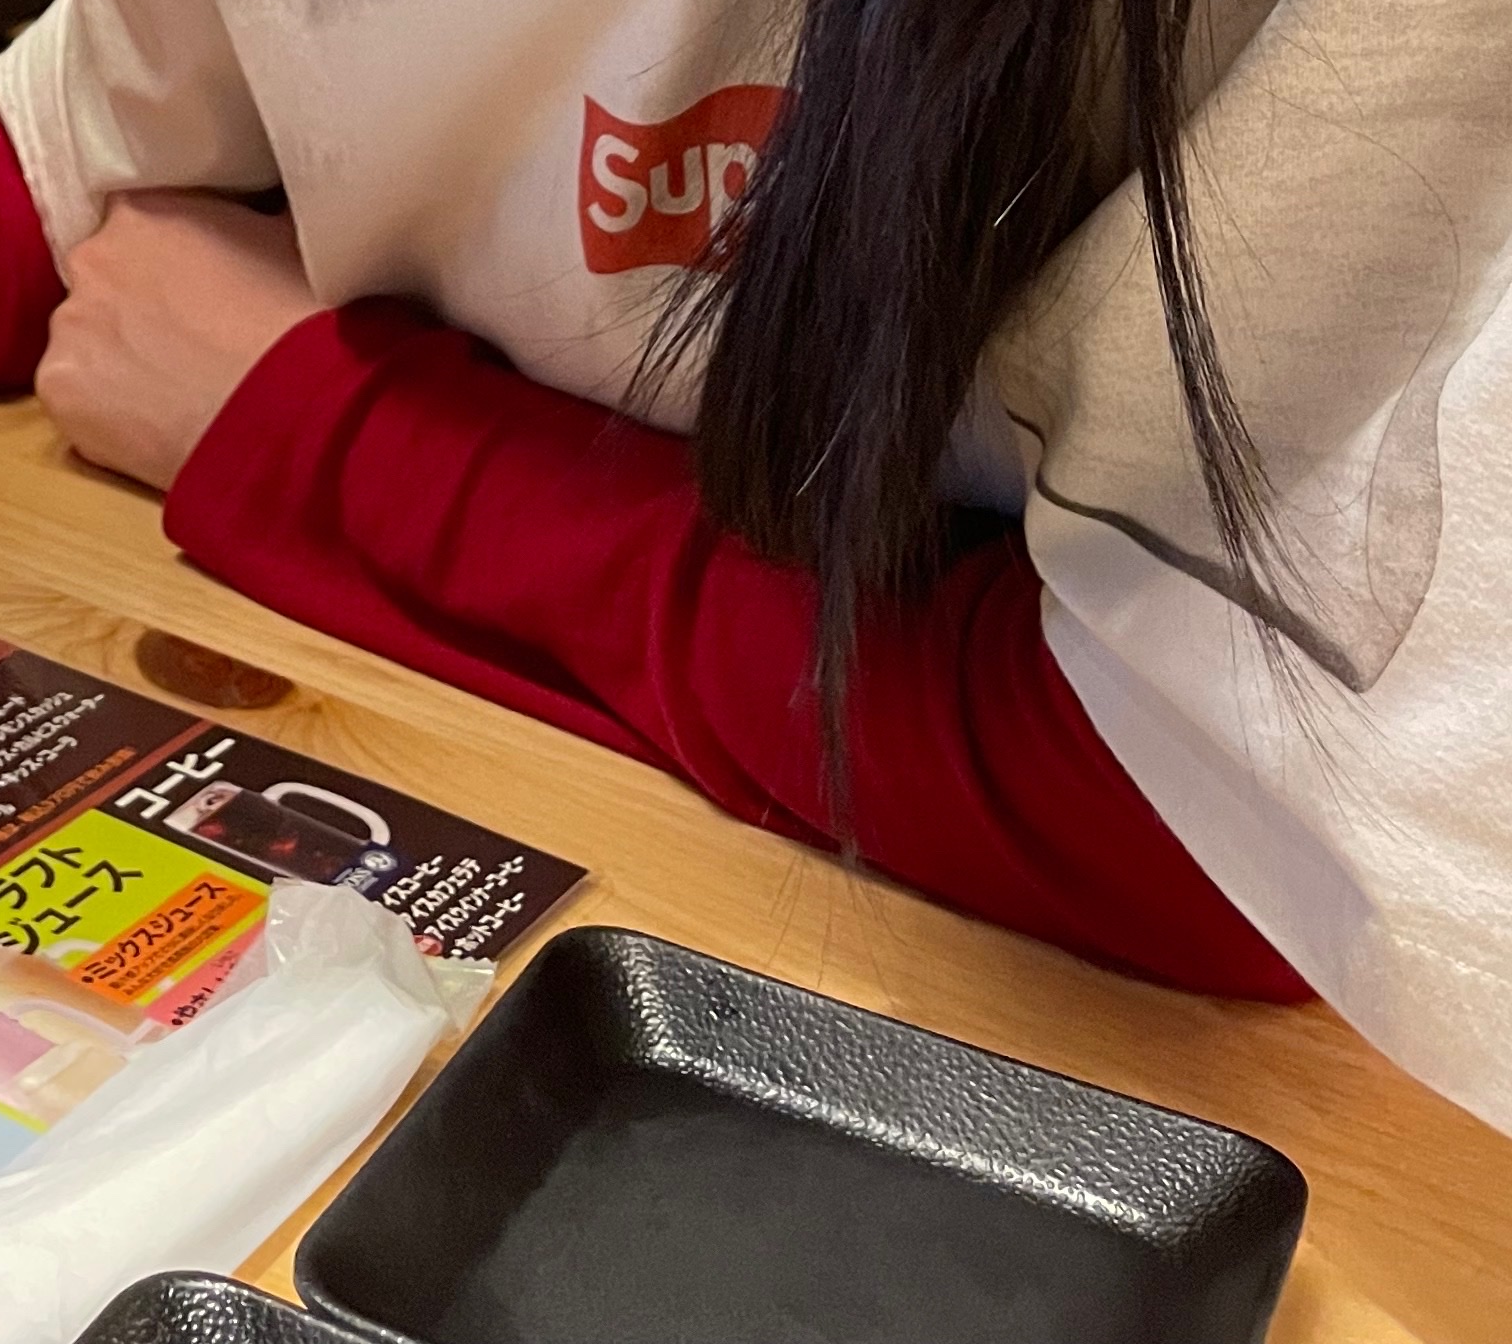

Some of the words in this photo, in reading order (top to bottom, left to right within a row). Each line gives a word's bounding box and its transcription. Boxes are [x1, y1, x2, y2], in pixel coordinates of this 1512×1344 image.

[0, 735, 78, 784] キッズ・コーラ
[114, 737, 235, 819] コーヒー
[84, 881, 227, 979] ミックスジュース
[454, 891, 524, 952] ホットコーヒー
